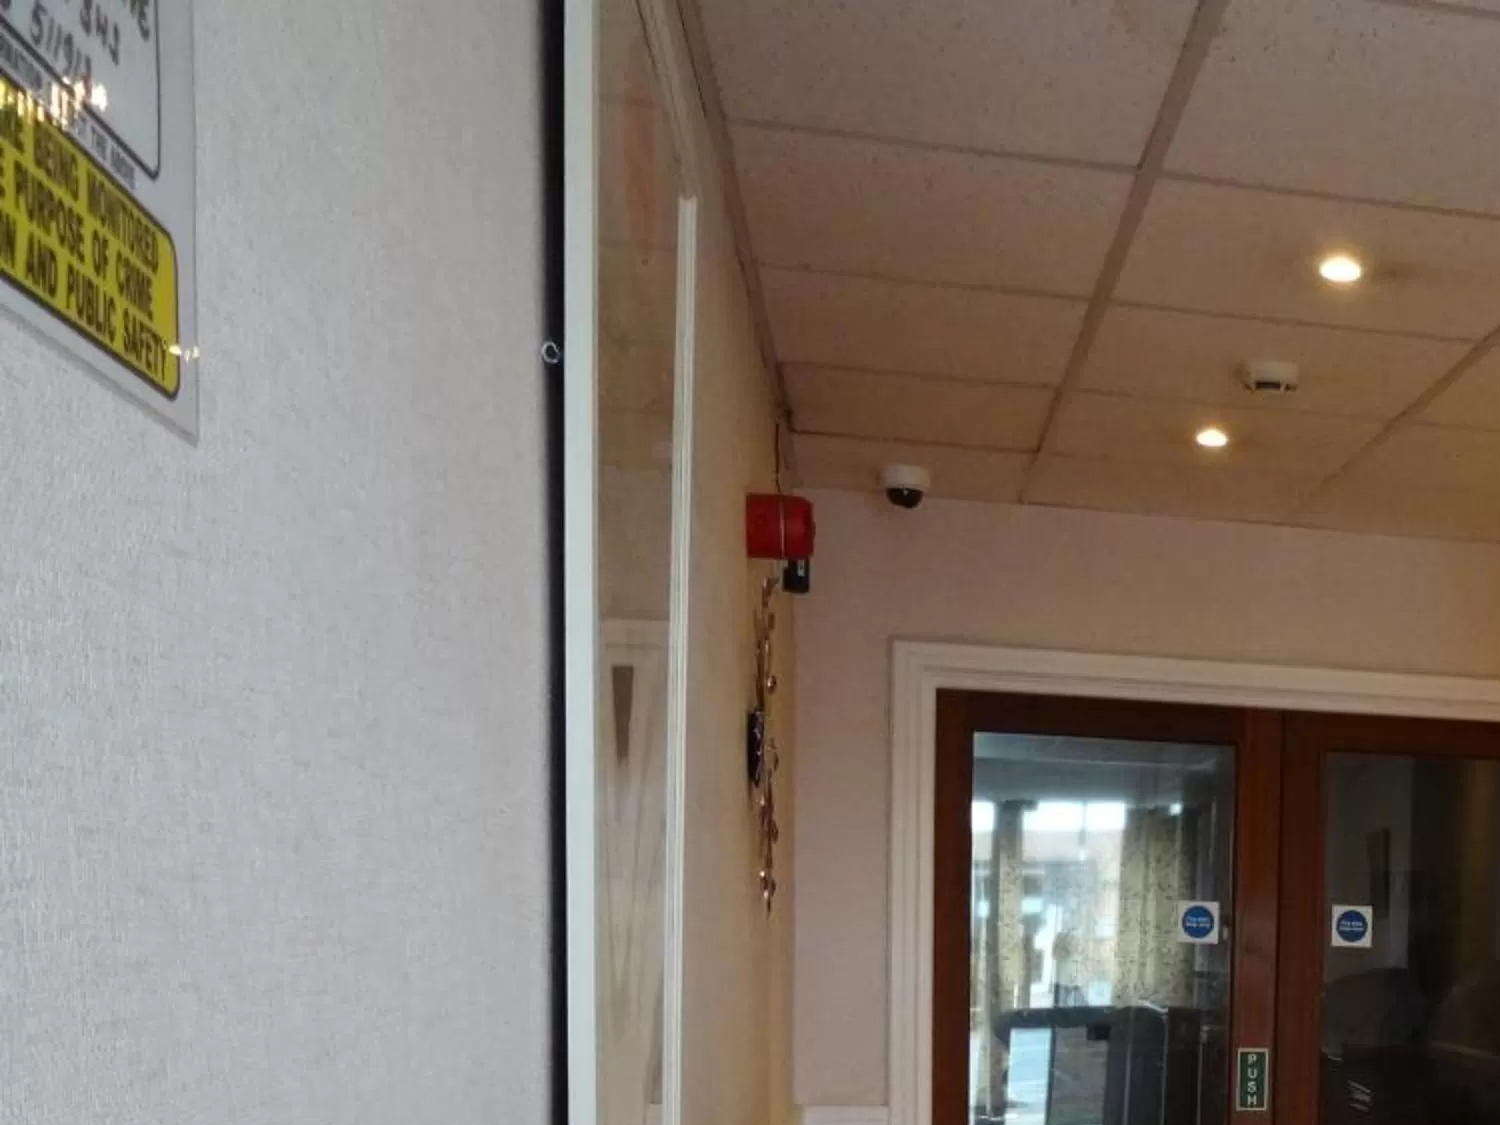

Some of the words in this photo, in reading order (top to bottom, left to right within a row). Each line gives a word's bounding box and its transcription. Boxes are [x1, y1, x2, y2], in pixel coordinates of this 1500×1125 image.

[14, 159, 85, 265] PURPOSE
[92, 228, 109, 281] OF
[116, 248, 154, 322] CRIME
[34, 120, 79, 203] BEING
[87, 166, 159, 276] MONITORED
[25, 230, 58, 299] AND
[66, 261, 116, 345] PUBLIC
[123, 307, 168, 382] SAFETY
[1247, 1053, 1257, 1105] PUSH
